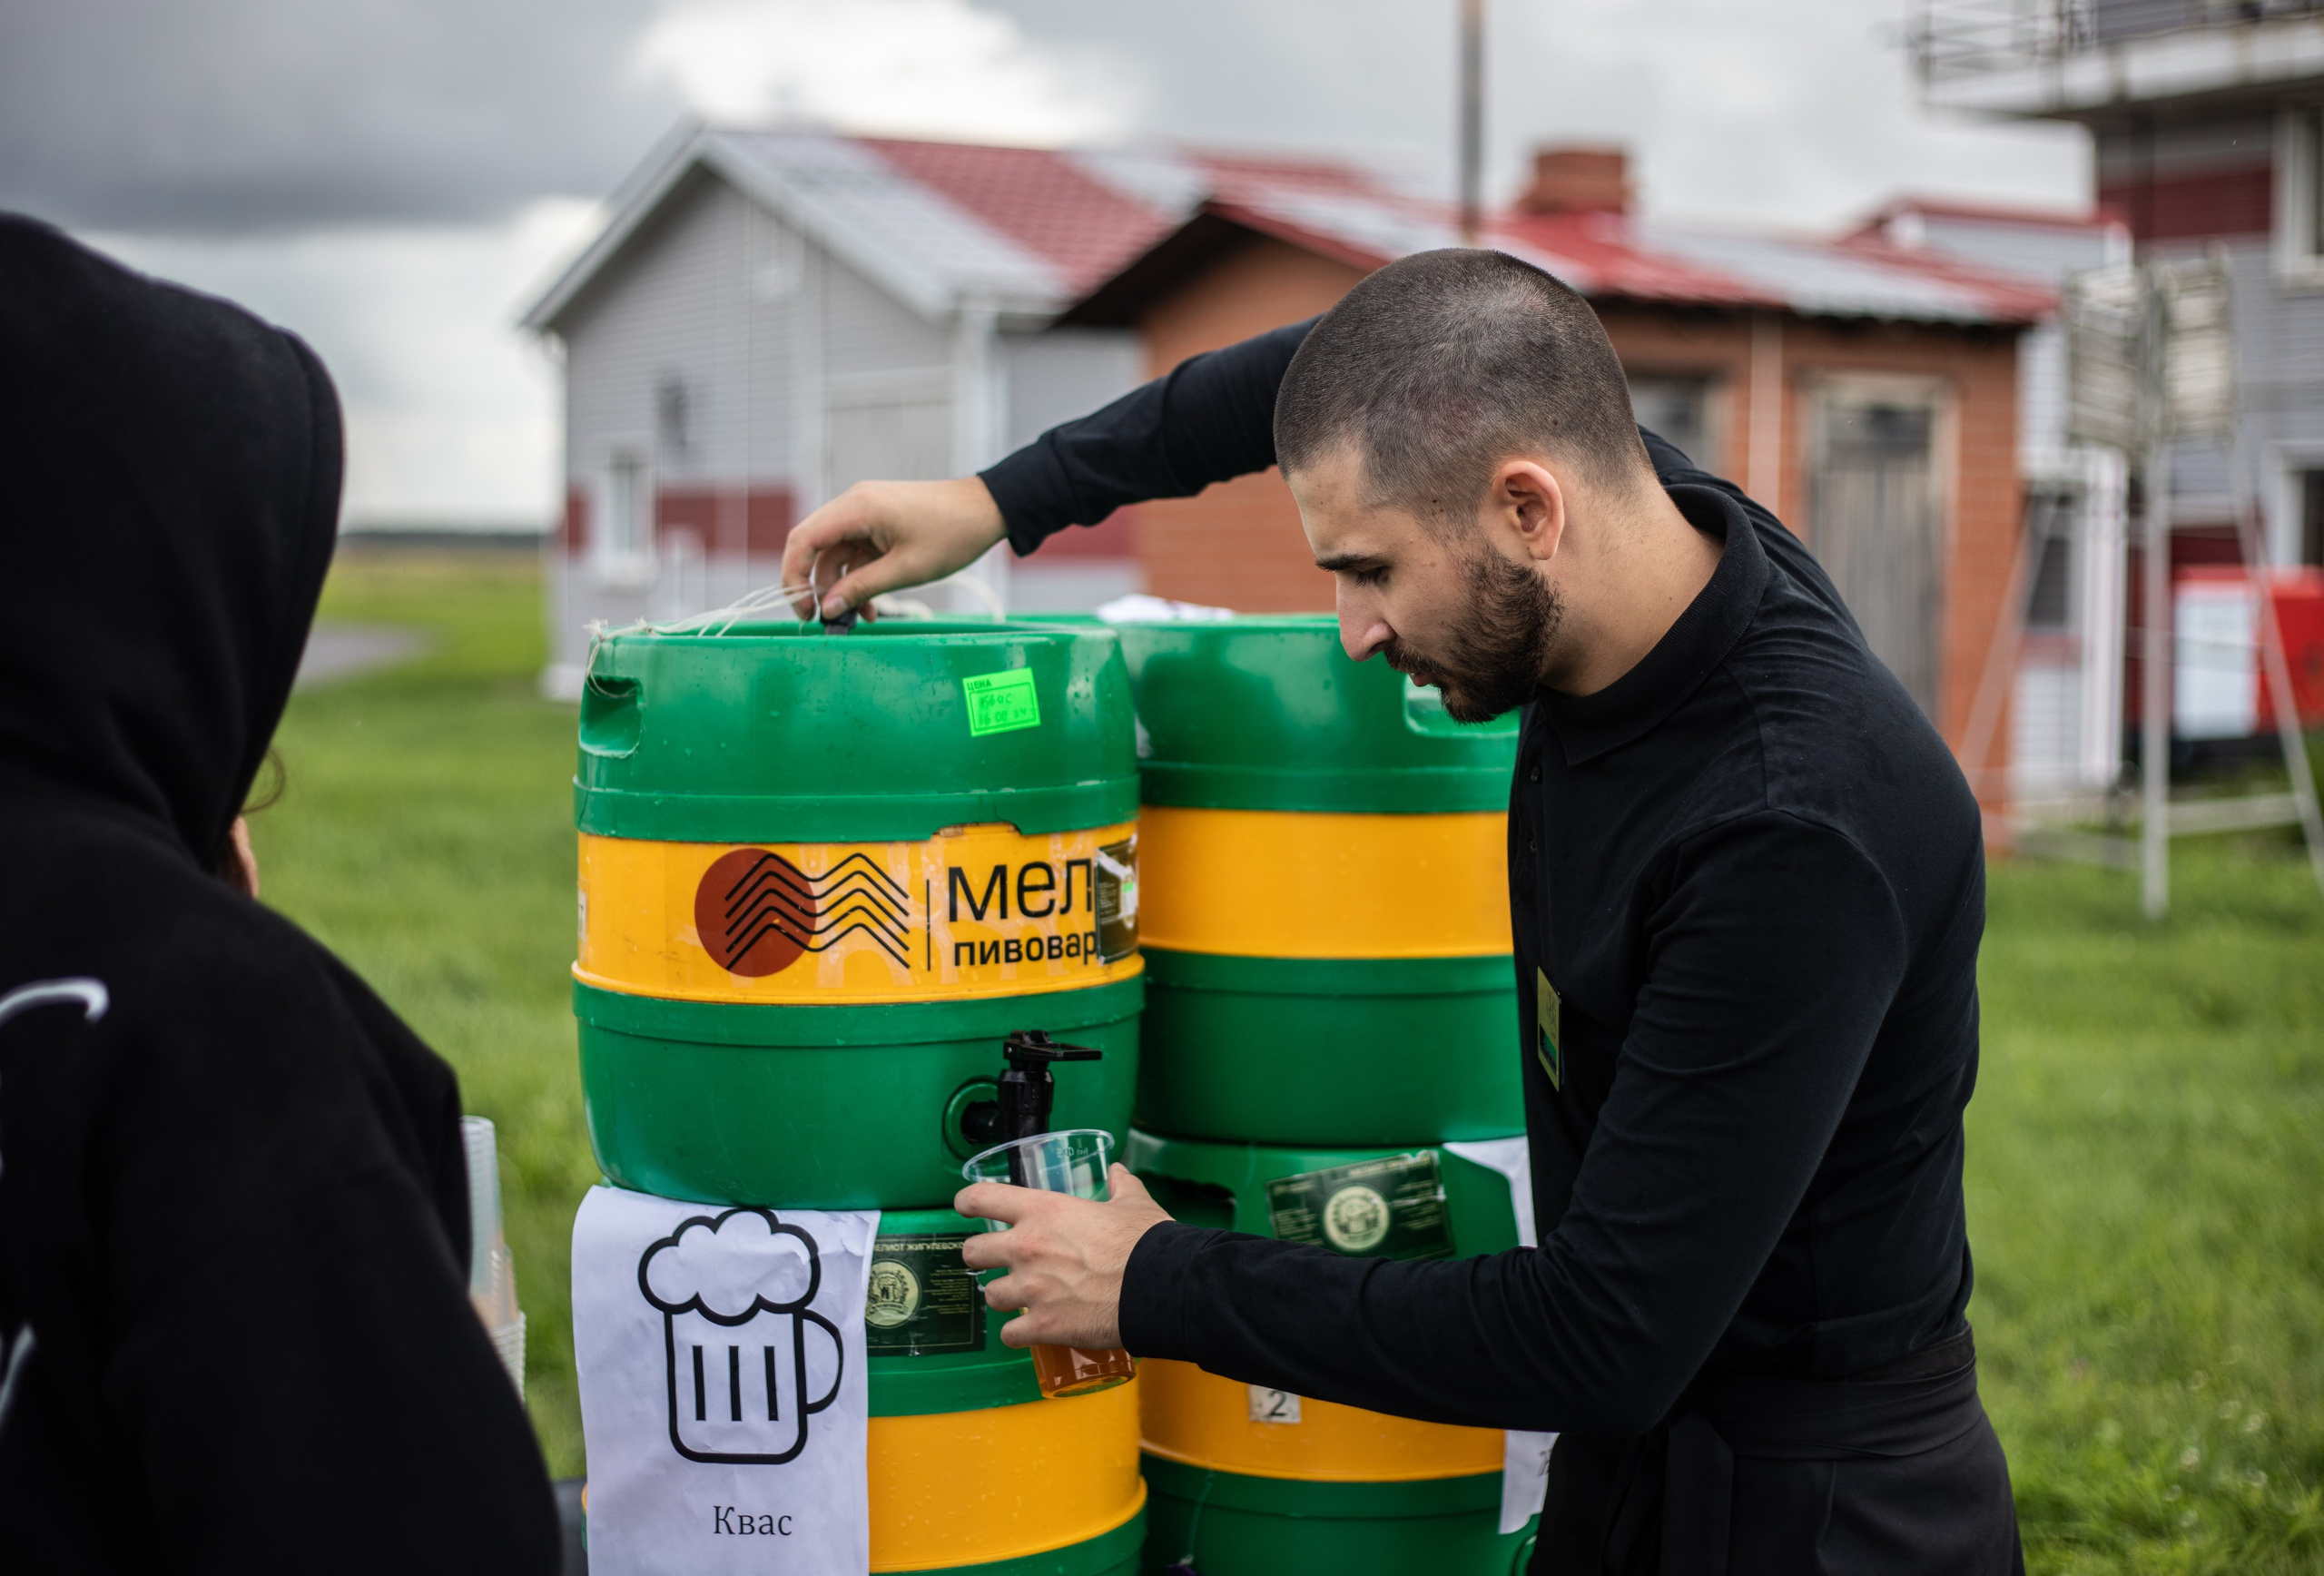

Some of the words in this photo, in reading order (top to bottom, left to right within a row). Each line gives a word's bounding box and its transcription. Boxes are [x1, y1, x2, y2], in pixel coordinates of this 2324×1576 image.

[967, 679, 991, 691] ЦЕНА
[954, 931, 1097, 966] пивовар
[1268, 1390, 1287, 1417] 2
[713, 1505, 793, 1536] Квас
